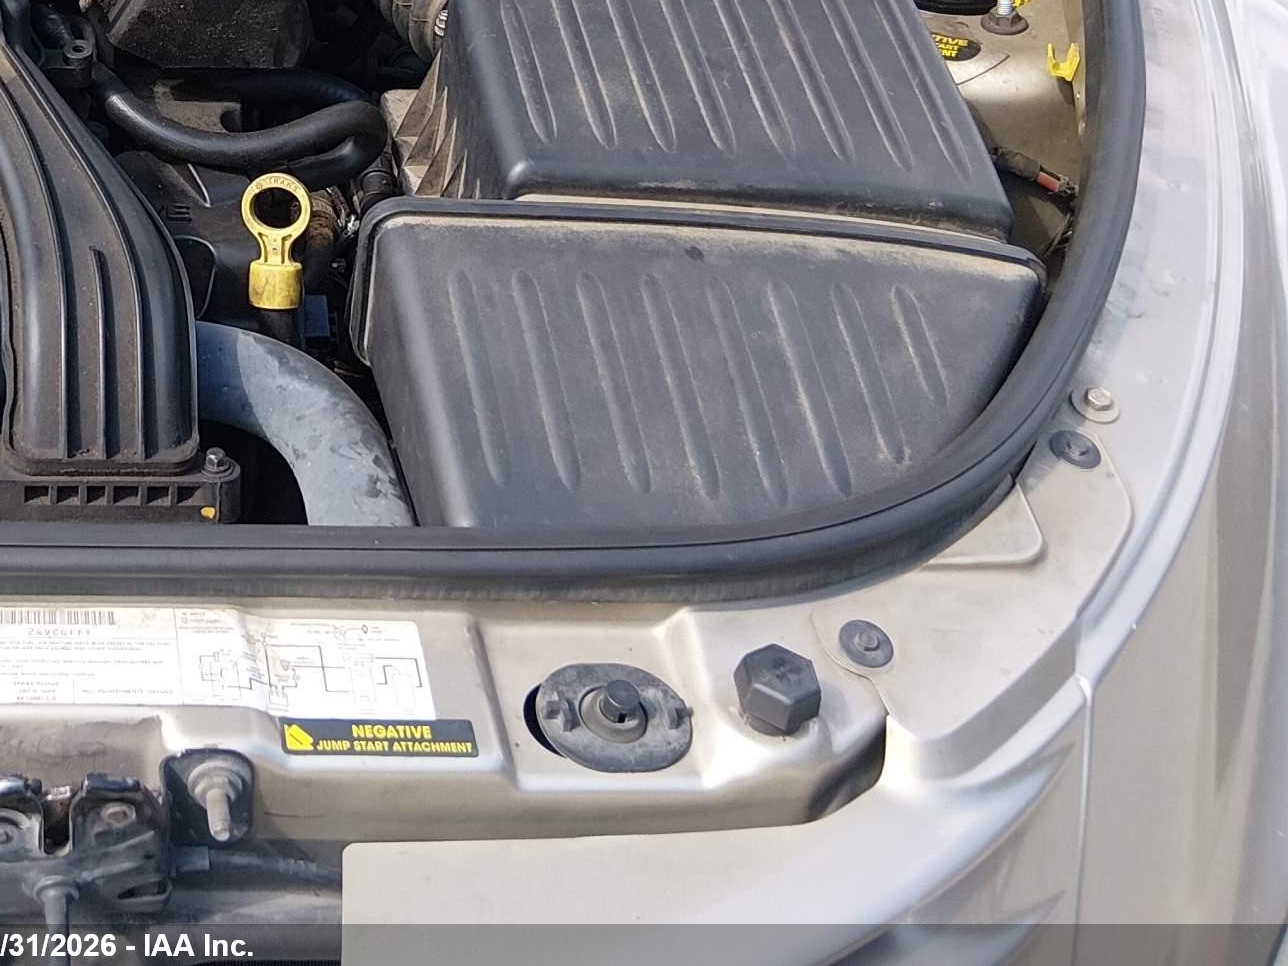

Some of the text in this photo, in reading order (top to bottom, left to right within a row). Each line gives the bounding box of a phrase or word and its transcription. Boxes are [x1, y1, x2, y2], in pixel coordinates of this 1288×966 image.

[352, 725, 431, 739] NEGATIVE
[316, 740, 472, 753] JUMP START ATTACHMENT
